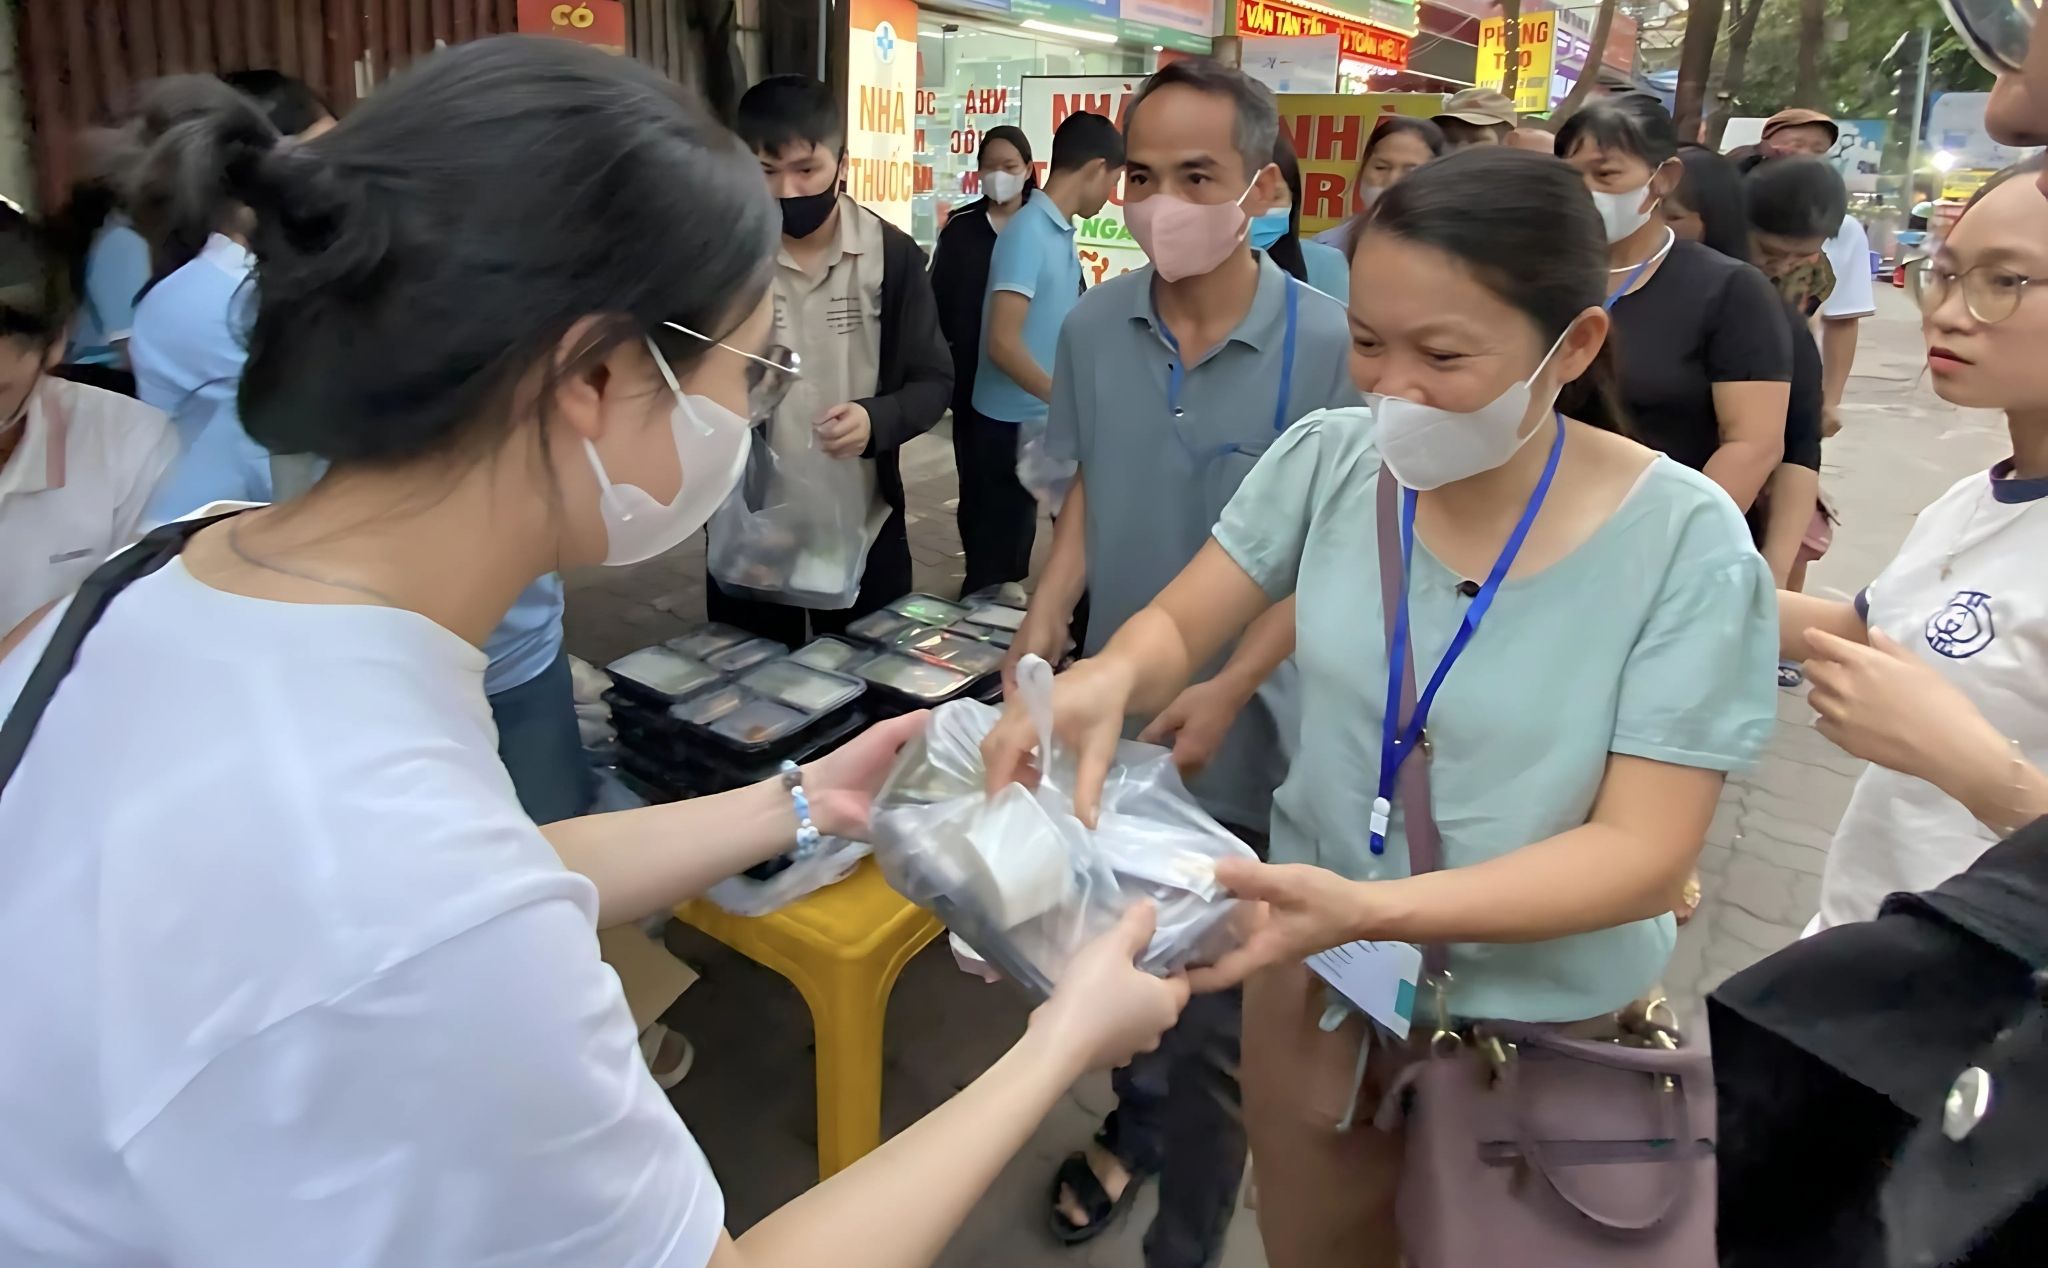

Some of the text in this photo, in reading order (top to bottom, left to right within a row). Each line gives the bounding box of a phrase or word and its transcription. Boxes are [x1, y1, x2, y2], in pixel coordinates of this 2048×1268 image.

[550, 2, 594, 28] CÓ
[1483, 21, 1548, 48] PHNG
[1493, 50, 1532, 72] TỌ
[860, 83, 905, 135] NHÀ
[1278, 104, 1396, 160] NH
[850, 146, 911, 202] THUỐC
